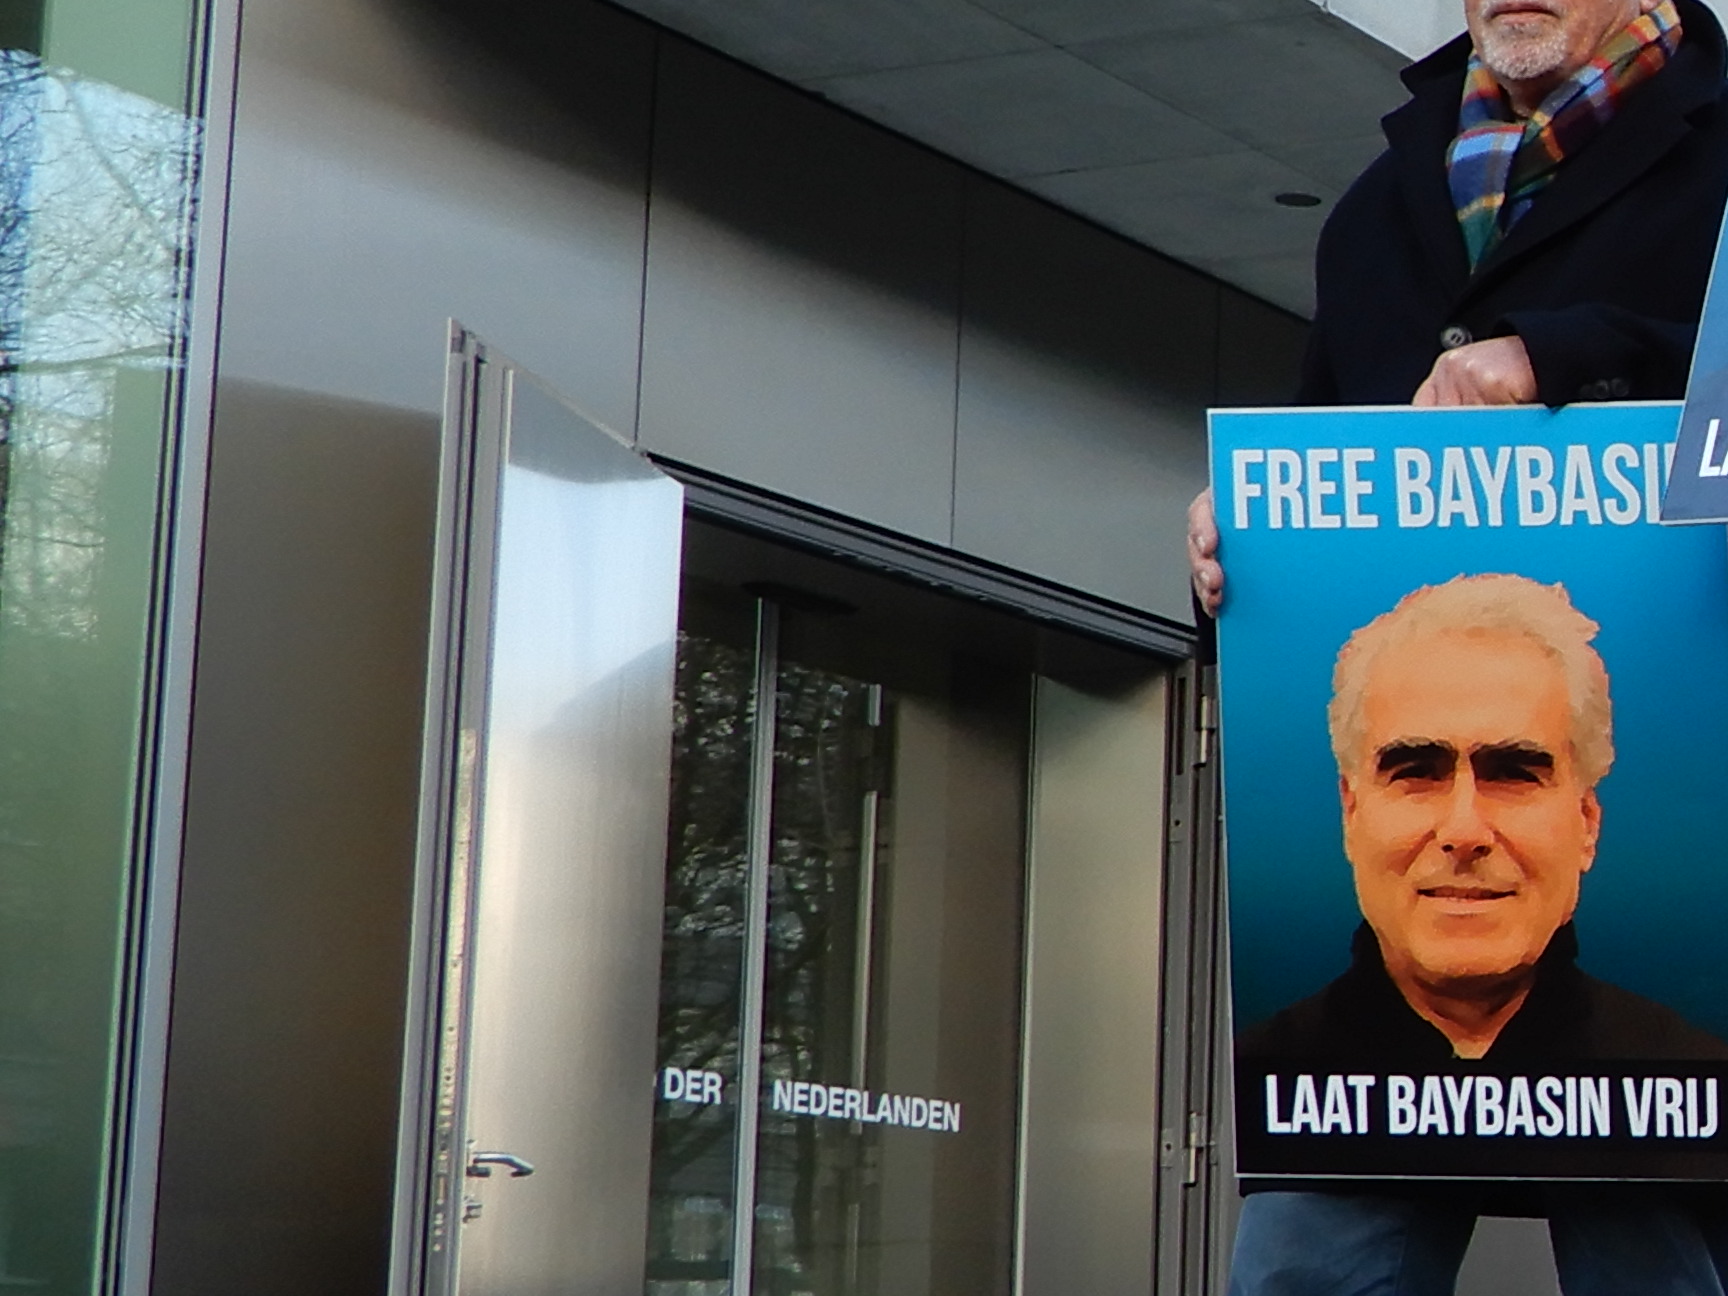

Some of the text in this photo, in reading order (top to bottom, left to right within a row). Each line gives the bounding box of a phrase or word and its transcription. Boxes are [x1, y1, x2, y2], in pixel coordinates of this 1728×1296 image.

[1232, 442, 1677, 531] FREE BAYBASI
[663, 1066, 961, 1133] DER NEDERLANDEN
[1265, 1073, 1720, 1138] LAAT BAYBASIN VRIJ
